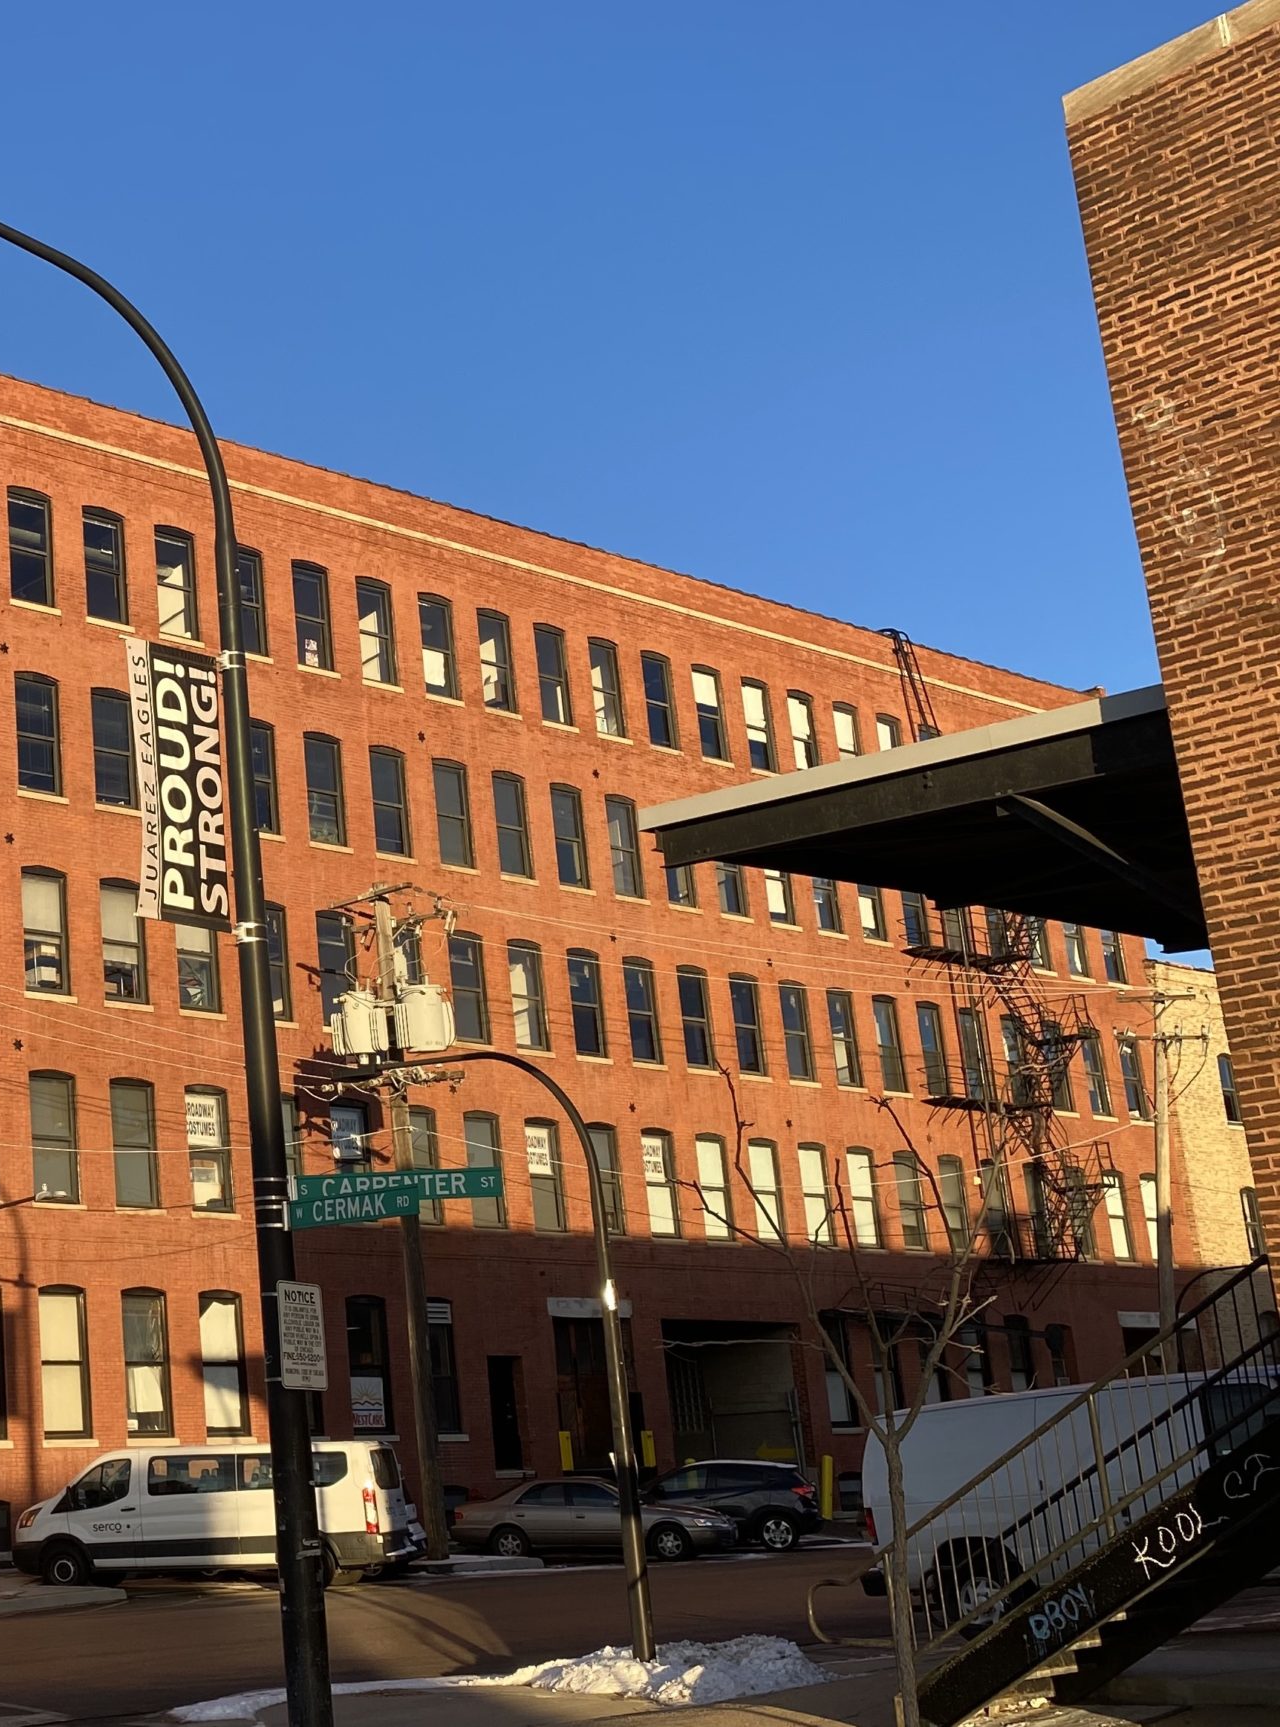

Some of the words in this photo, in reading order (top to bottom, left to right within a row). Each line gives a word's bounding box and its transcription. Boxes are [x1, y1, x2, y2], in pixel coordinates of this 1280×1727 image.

[132, 655, 153, 767] EAGLES
[153, 658, 195, 911] PROUD!
[188, 666, 228, 916] STRONG!
[142, 782, 158, 901] JUÁREZ
[185, 1102, 215, 1118] ROADWAY
[301, 1185, 308, 1196] S
[480, 1176, 495, 1188] ST
[296, 1207, 303, 1219] W
[313, 1193, 386, 1222] CERMAK
[396, 1196, 409, 1208] RD
[284, 1289, 316, 1304] NOTICE
[92, 1522, 122, 1533] serco
